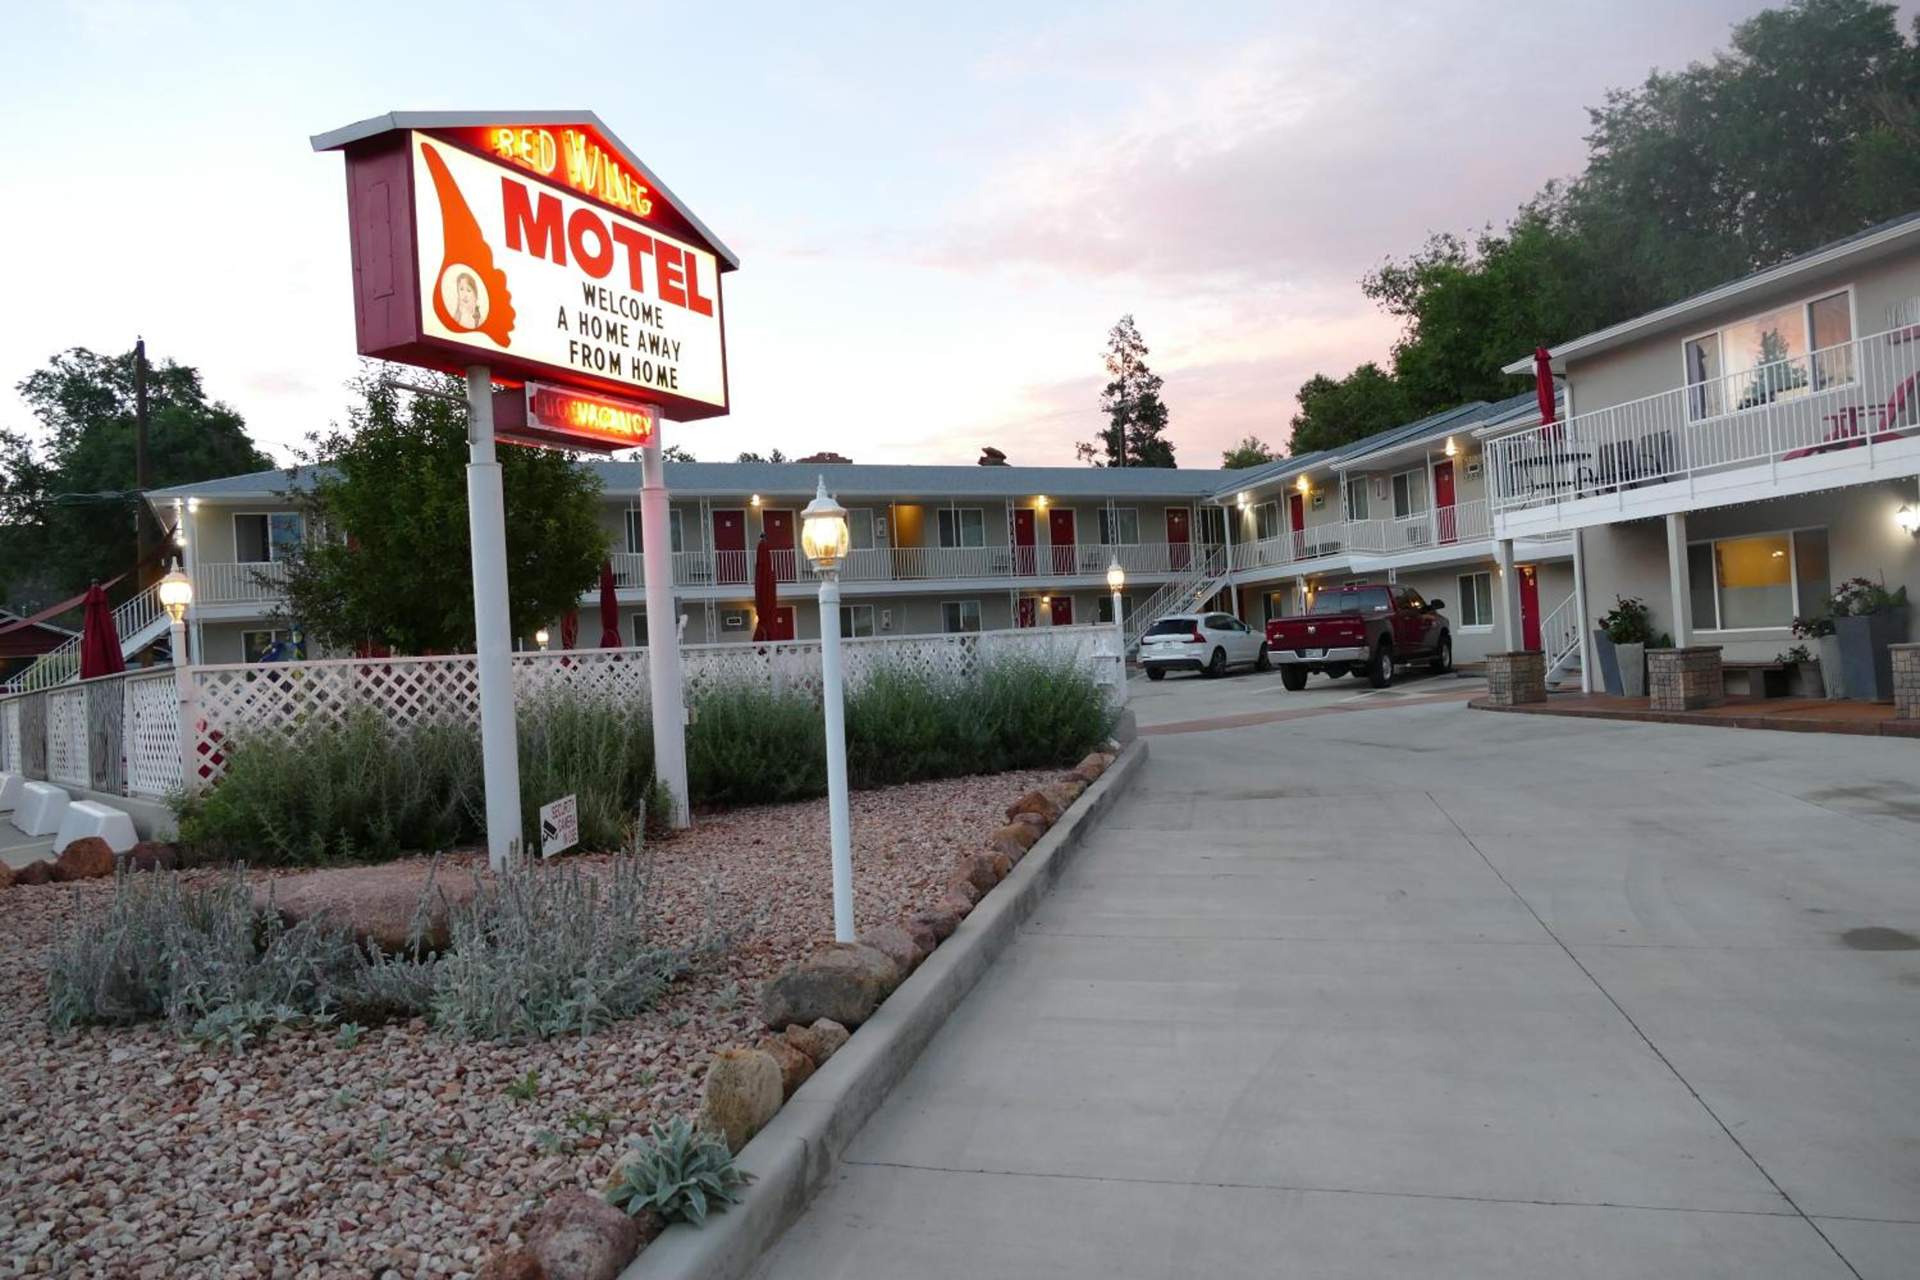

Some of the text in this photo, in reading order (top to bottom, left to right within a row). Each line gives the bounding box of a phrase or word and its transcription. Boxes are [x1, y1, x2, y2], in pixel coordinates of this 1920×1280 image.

[497, 127, 653, 216] RED WING
[501, 176, 713, 318] MOTEL
[582, 281, 664, 330] WELCOME
[557, 305, 681, 363] A HOME AWAY
[569, 339, 679, 390] FROM HOME
[571, 400, 653, 435] VACANCY
